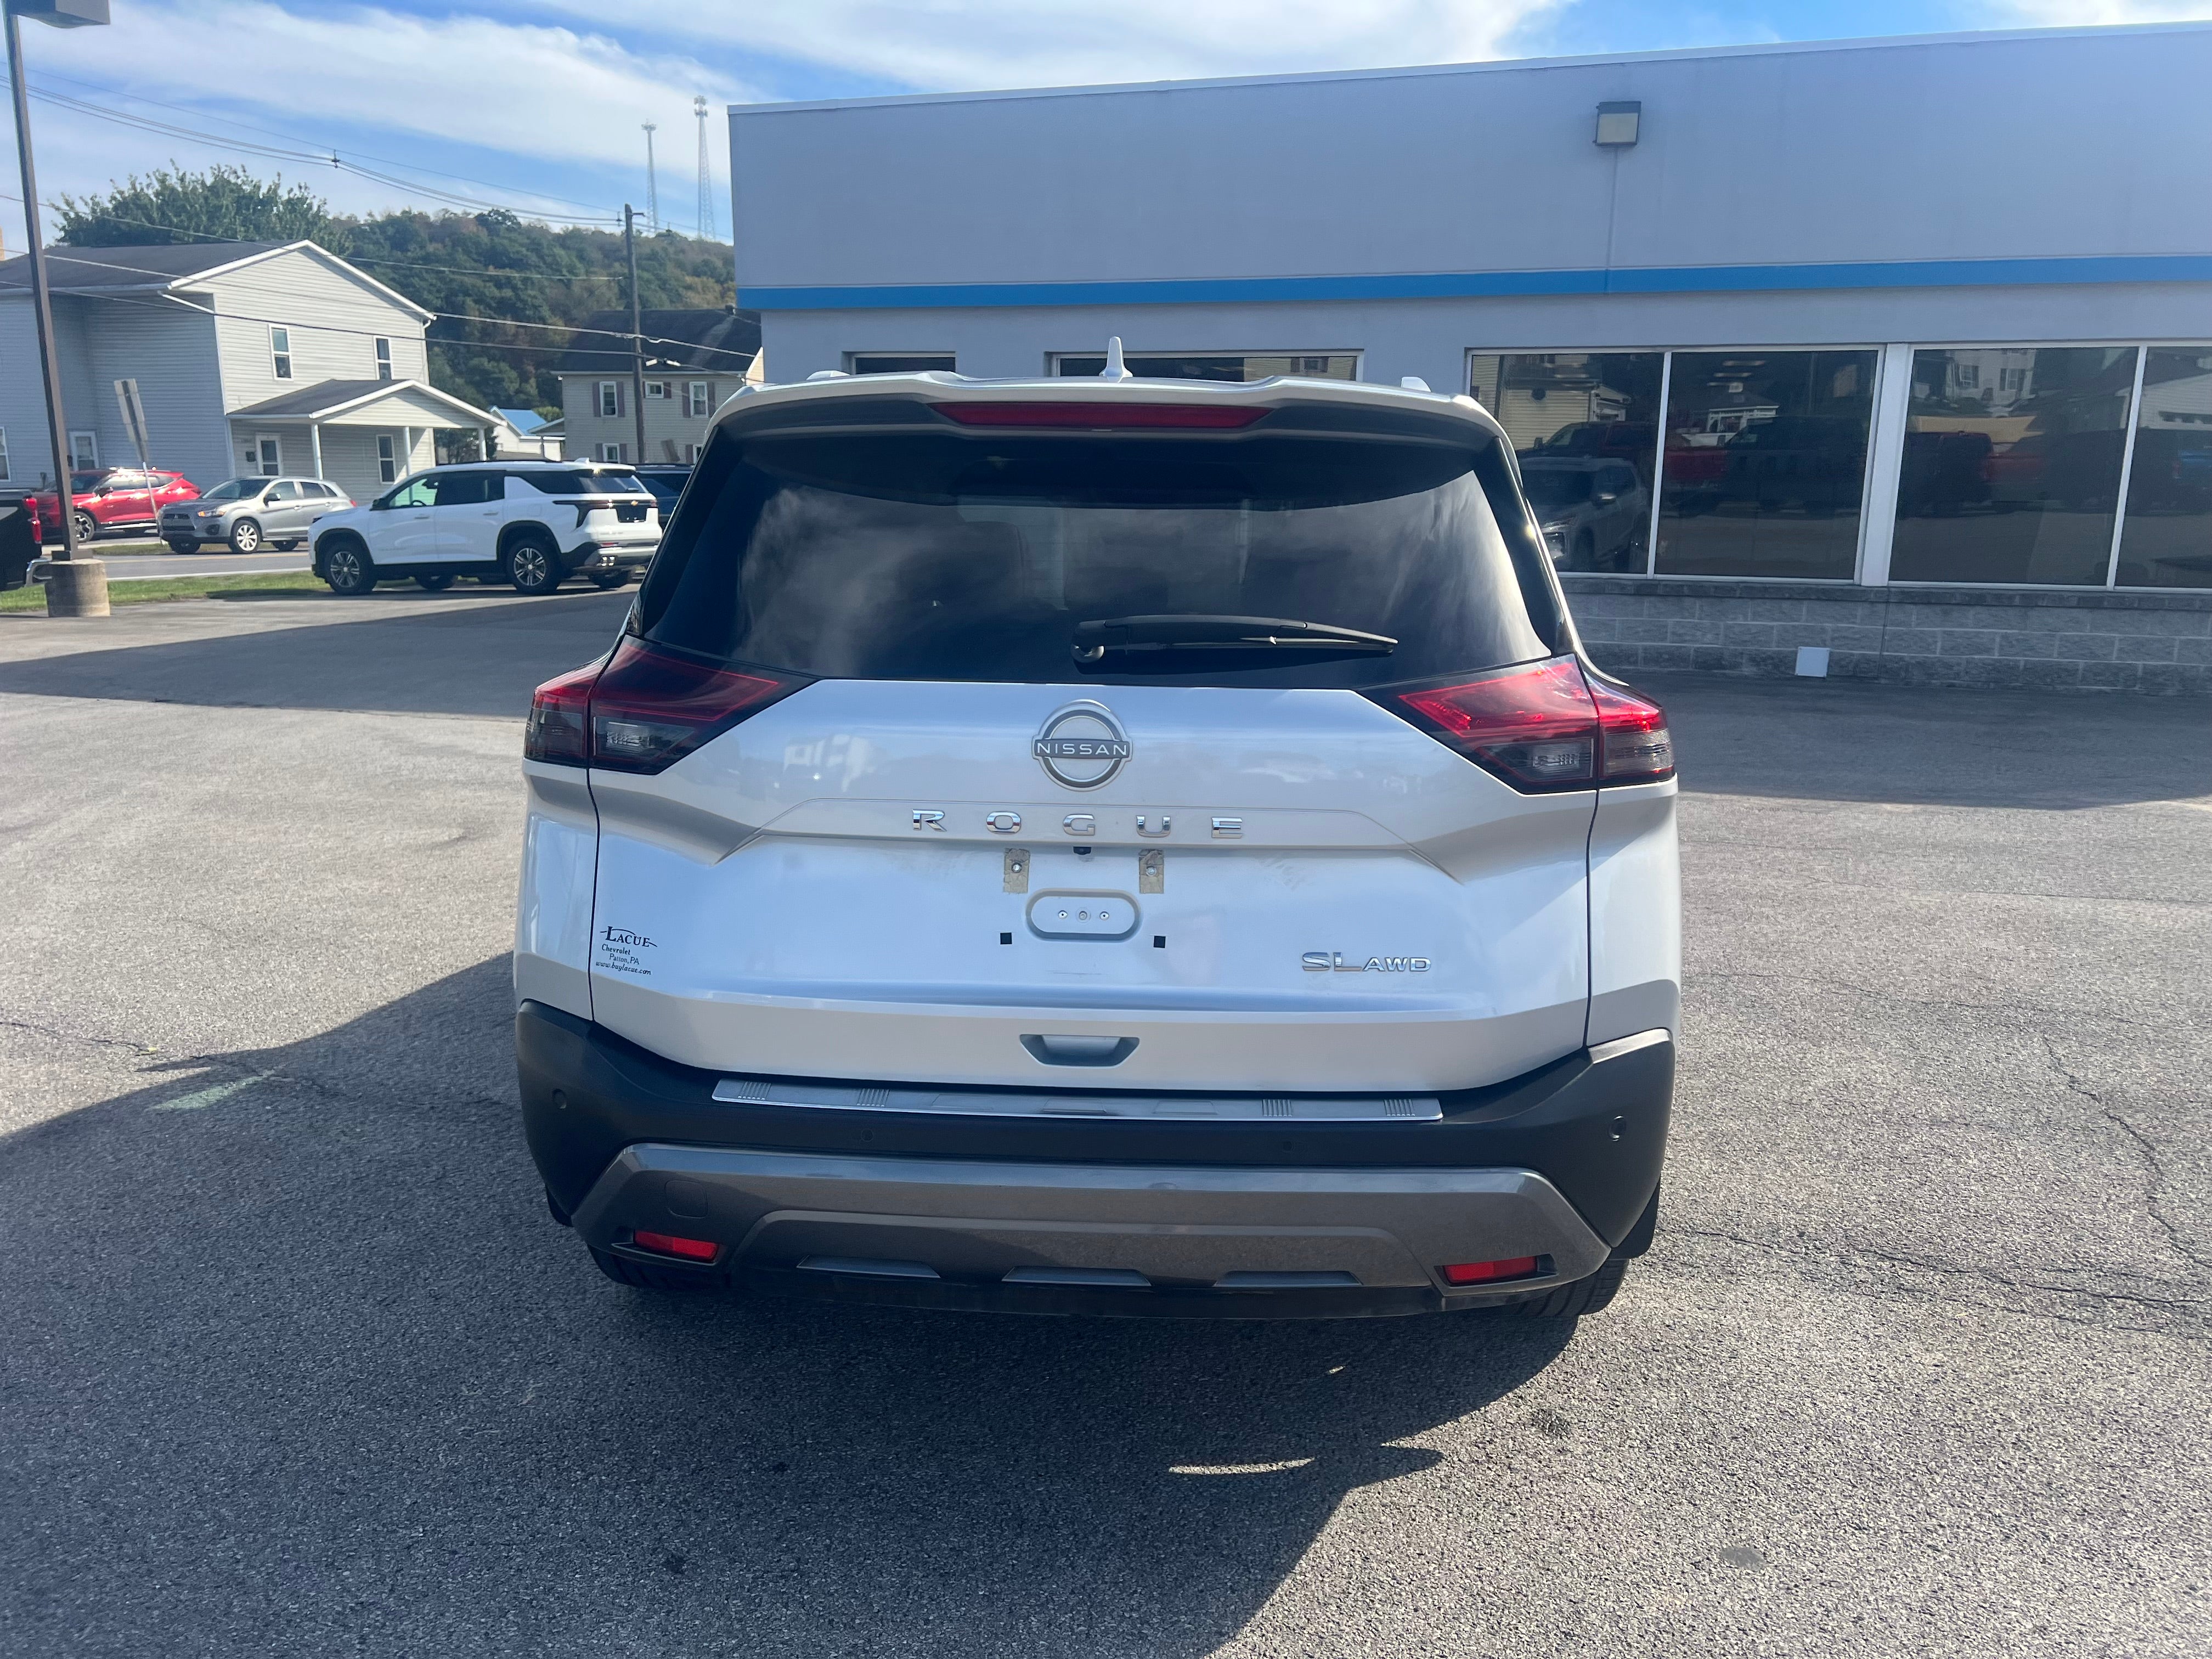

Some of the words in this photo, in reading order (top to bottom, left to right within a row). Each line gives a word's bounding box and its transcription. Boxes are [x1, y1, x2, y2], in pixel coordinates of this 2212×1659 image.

[1037, 742, 1127, 755] NISSAN
[912, 809, 1243, 839] ROGUE
[601, 943, 630, 955] Chevrolet
[629, 956, 640, 965] PA
[1302, 952, 1362, 972] SL
[1362, 957, 1431, 972] AWD
[595, 962, 651, 975] www.buylacue.com
